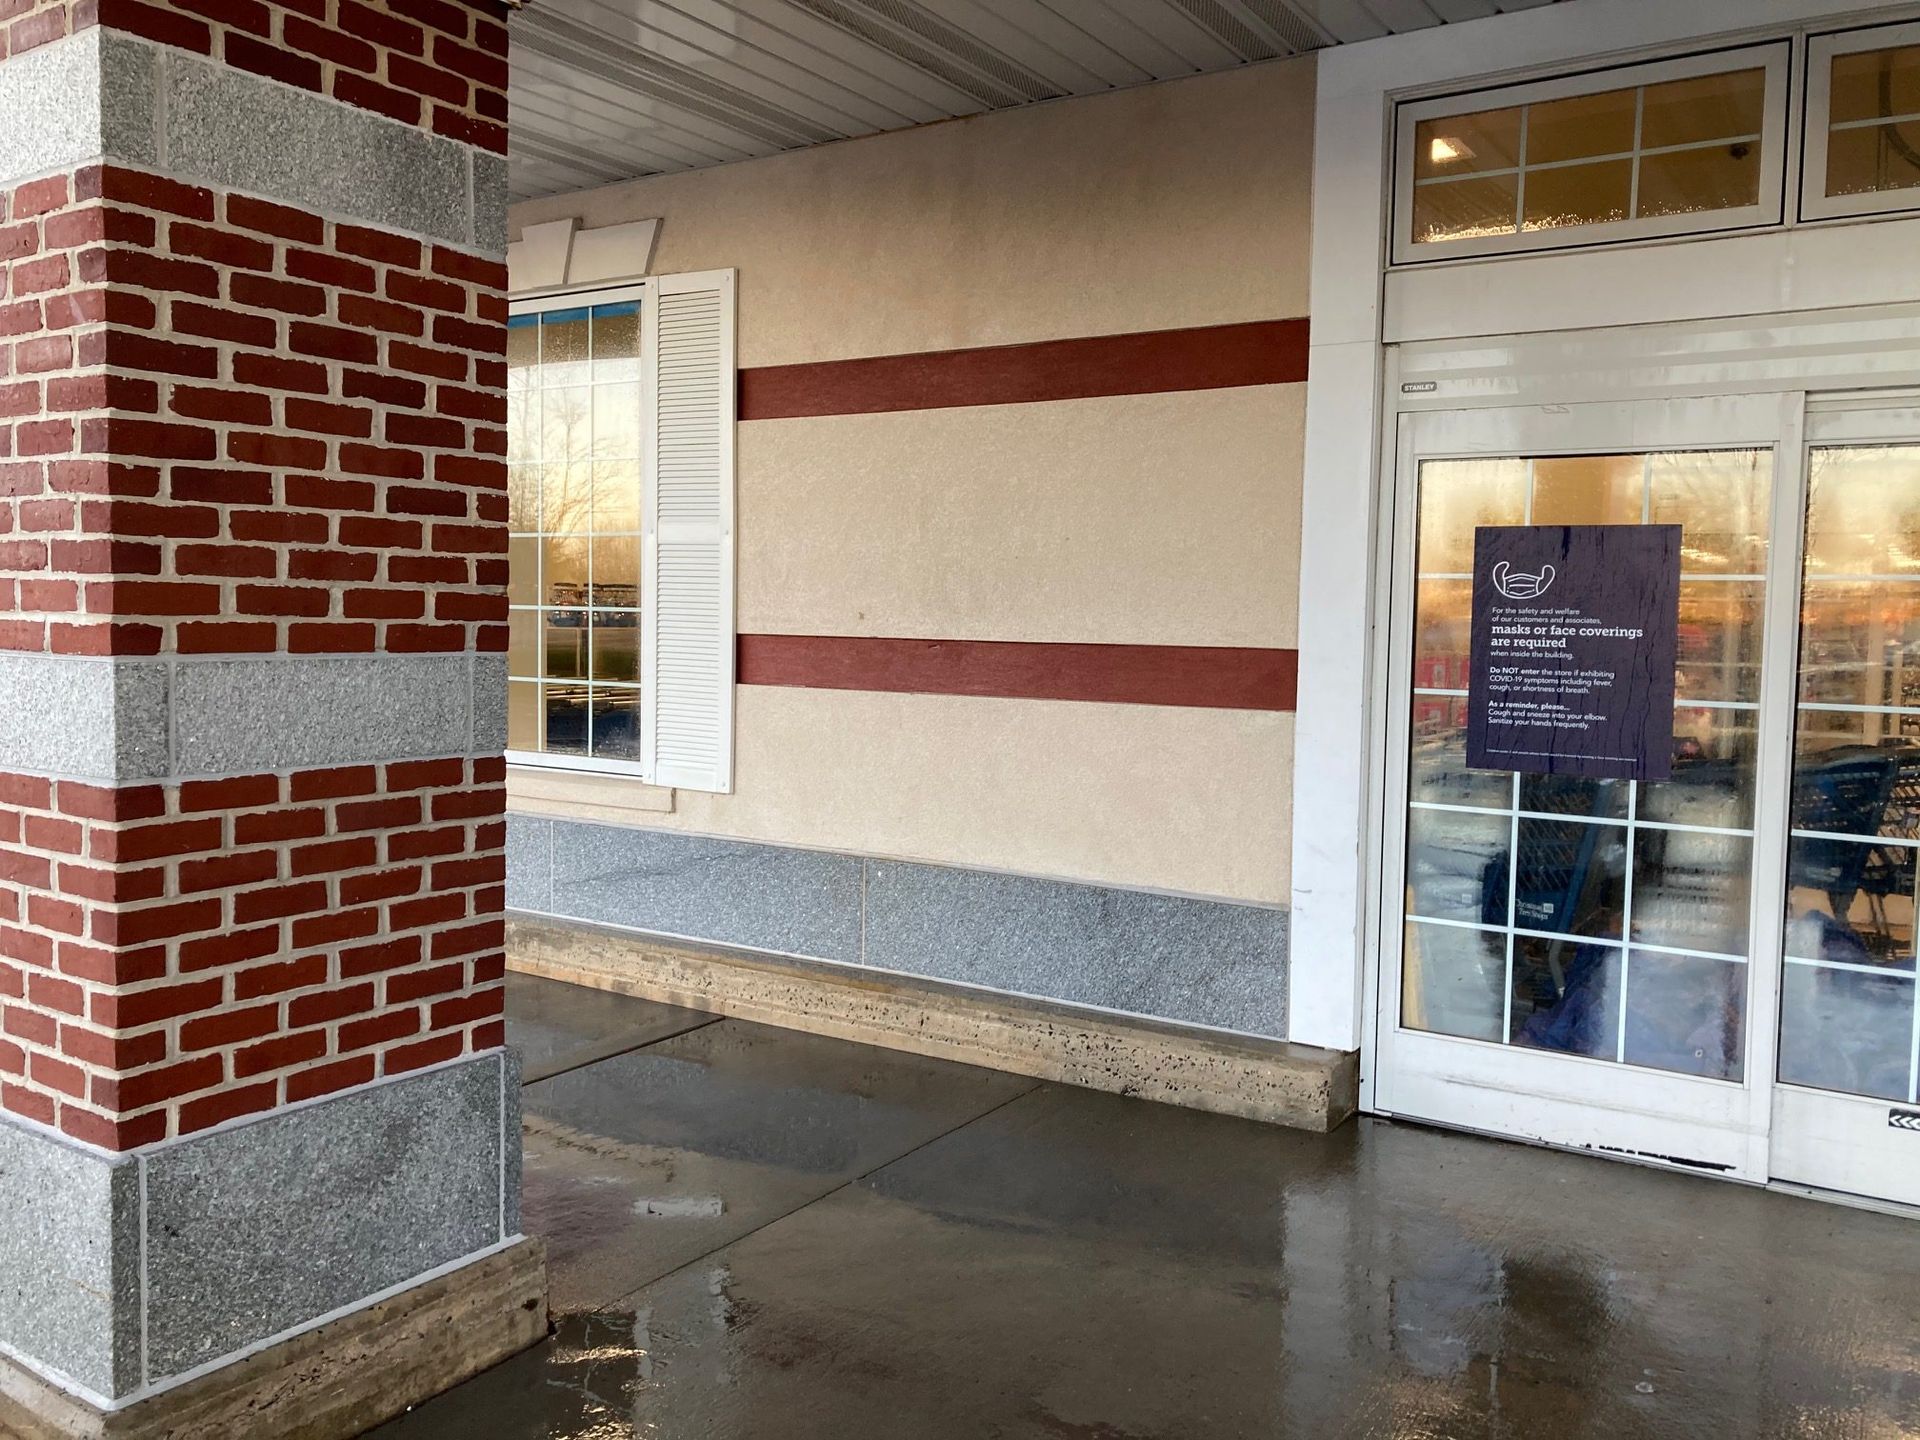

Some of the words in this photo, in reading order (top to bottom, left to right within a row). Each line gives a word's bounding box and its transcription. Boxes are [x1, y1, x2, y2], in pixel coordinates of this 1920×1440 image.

[1492, 625, 1530, 634] masks
[1534, 627, 1546, 635] or
[1550, 625, 1576, 635] face
[1579, 627, 1643, 639] coverings
[1491, 638, 1510, 646] are
[1513, 638, 1566, 649] required
[1545, 652, 1574, 660] building.
[1581, 670, 1614, 679] exhibiting
[1561, 679, 1591, 687] including
[1594, 679, 1612, 687] fever,
[1489, 684, 1511, 692] cough,
[1506, 701, 1539, 709] reminder,
[1488, 709, 1511, 717] Cough
[1488, 717, 1513, 725] Sanitize
[1532, 718, 1552, 726] hands
[1554, 720, 1589, 730] frequently.
